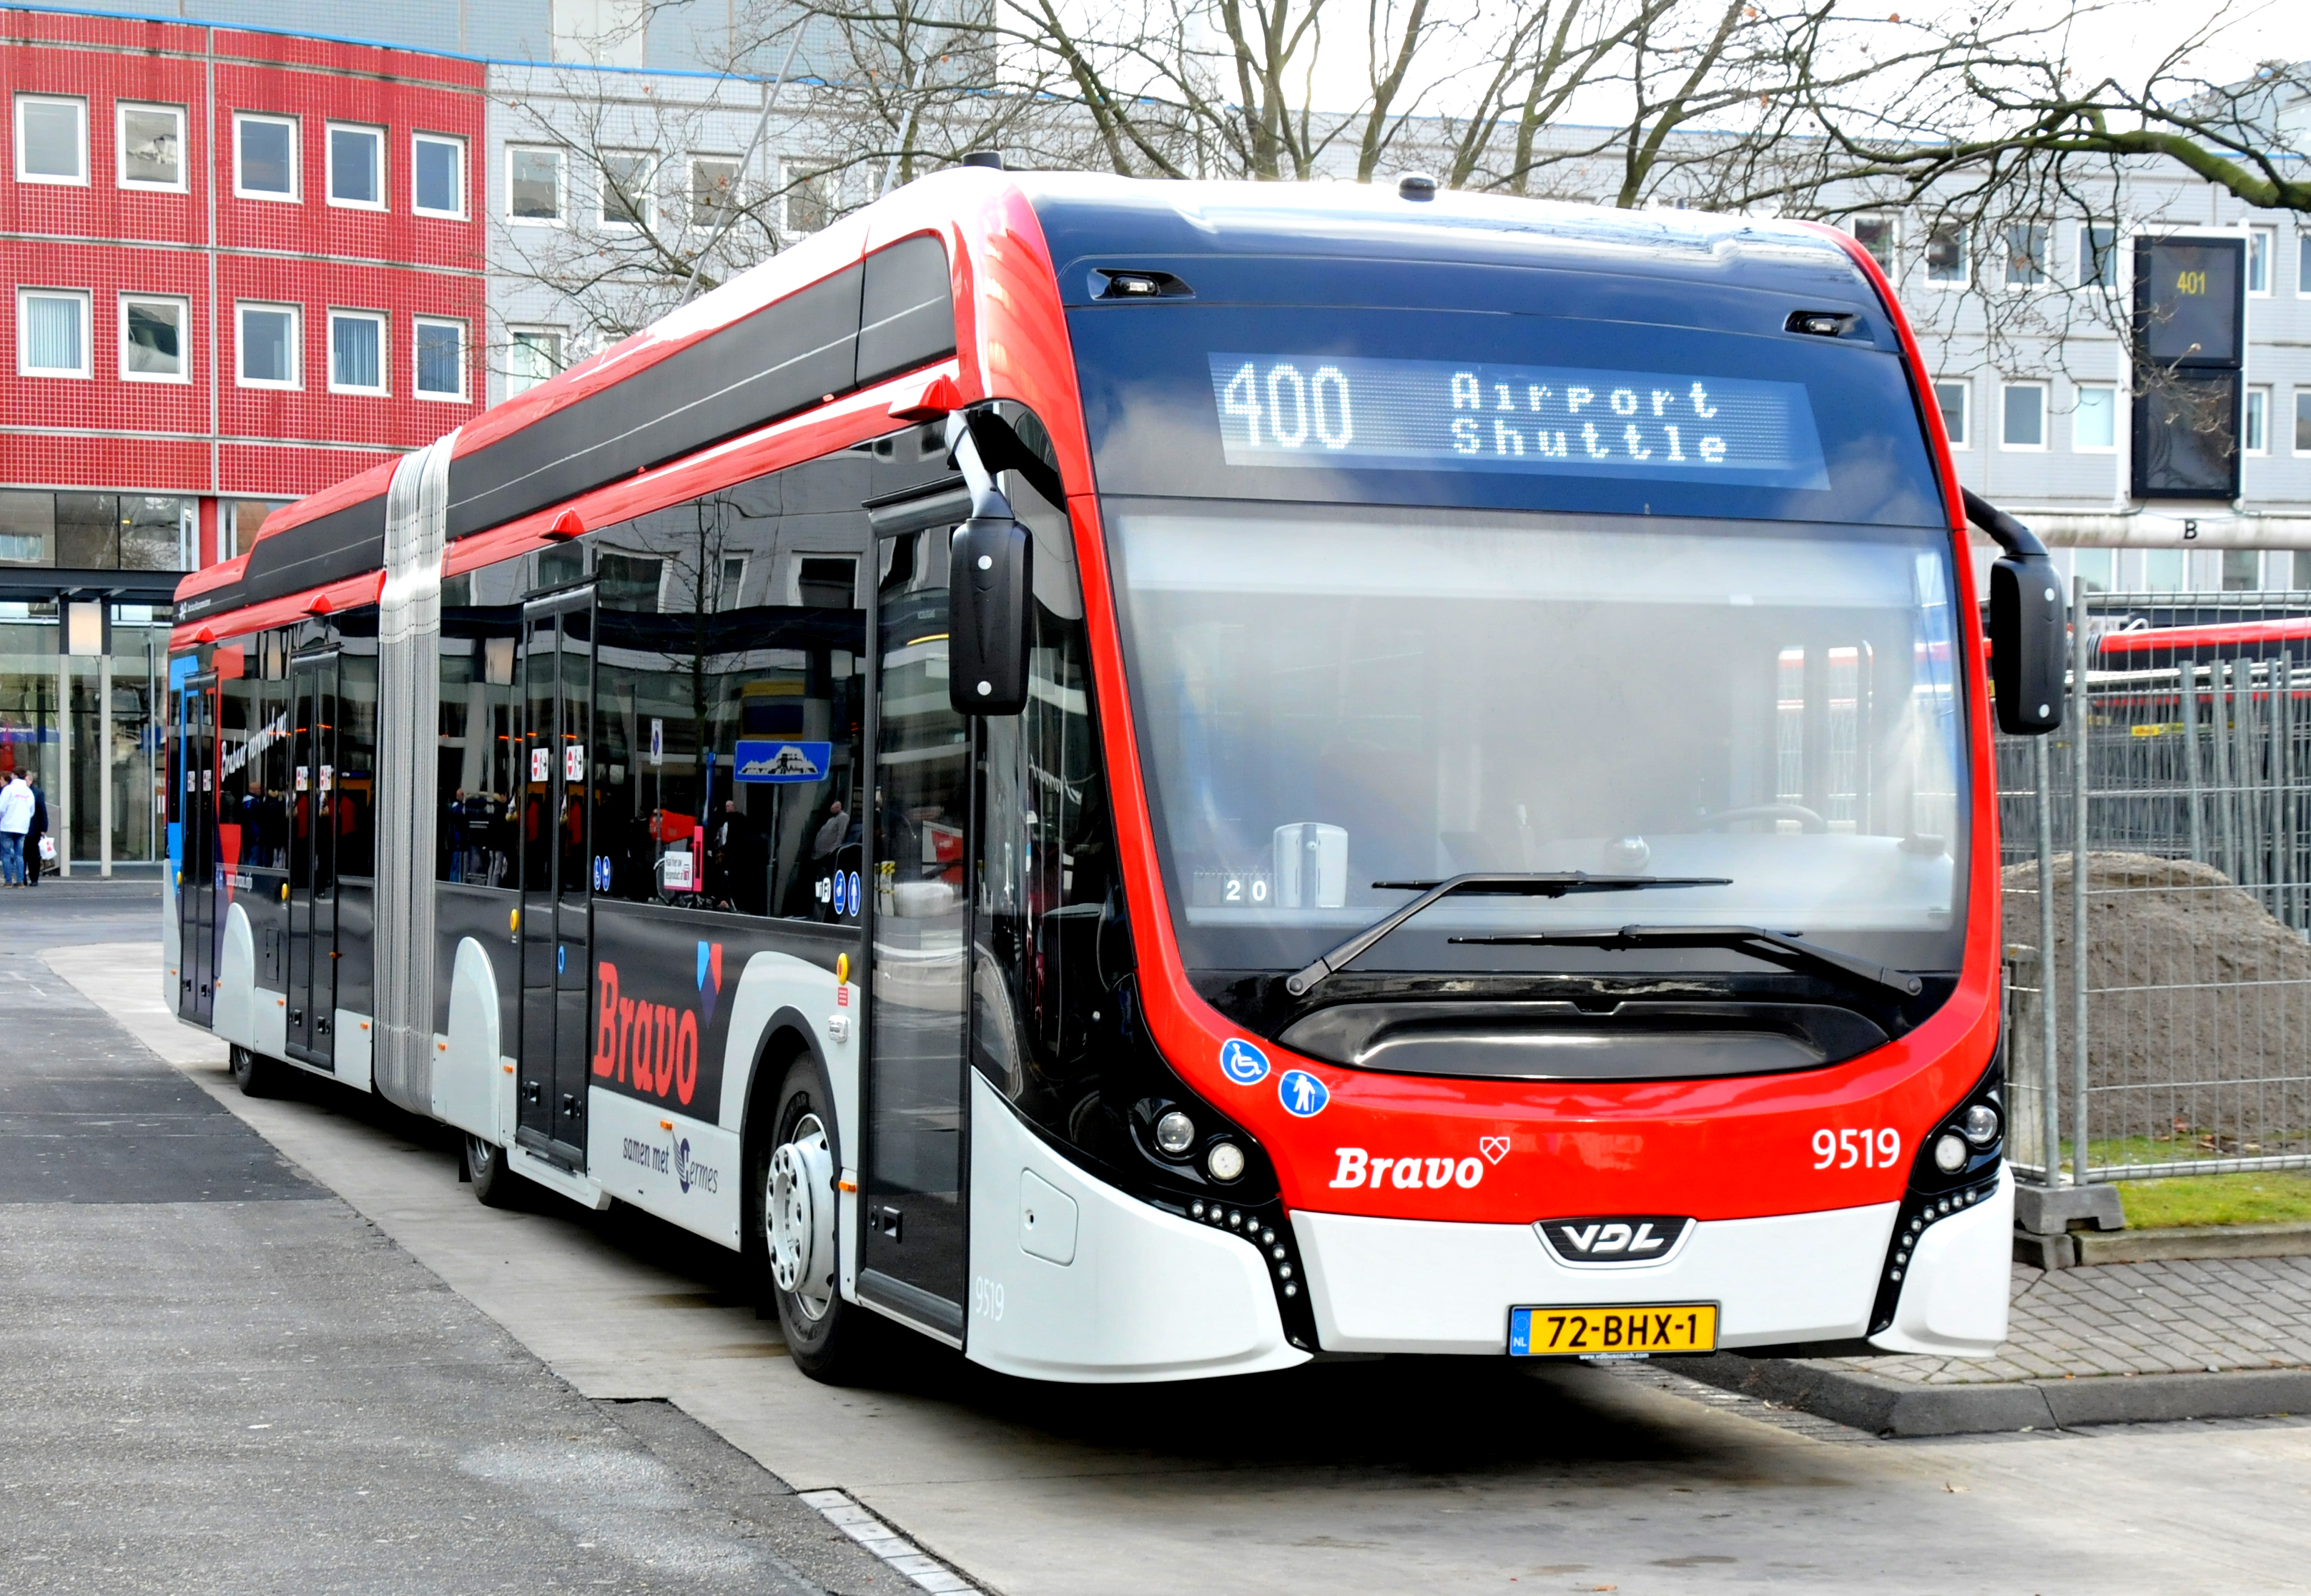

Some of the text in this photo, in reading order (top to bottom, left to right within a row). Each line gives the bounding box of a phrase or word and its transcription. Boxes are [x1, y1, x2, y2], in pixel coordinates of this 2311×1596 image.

[2176, 270, 2206, 295] 401
[1223, 362, 1353, 449] 400
[1451, 370, 1718, 418] Airport
[1451, 418, 1727, 463] Shuttle
[2183, 518, 2198, 540] B
[593, 961, 699, 1105] Bravo
[623, 1137, 650, 1168] samen
[652, 1145, 669, 1175] met
[1328, 1147, 1484, 1189] Bravo
[1811, 1128, 1901, 1170] 9519
[1560, 1223, 1665, 1253] VDL
[975, 1275, 1005, 1321] 9519
[1513, 1336, 1527, 1347] NL
[1547, 1314, 1697, 1348] 72-BHX-1
